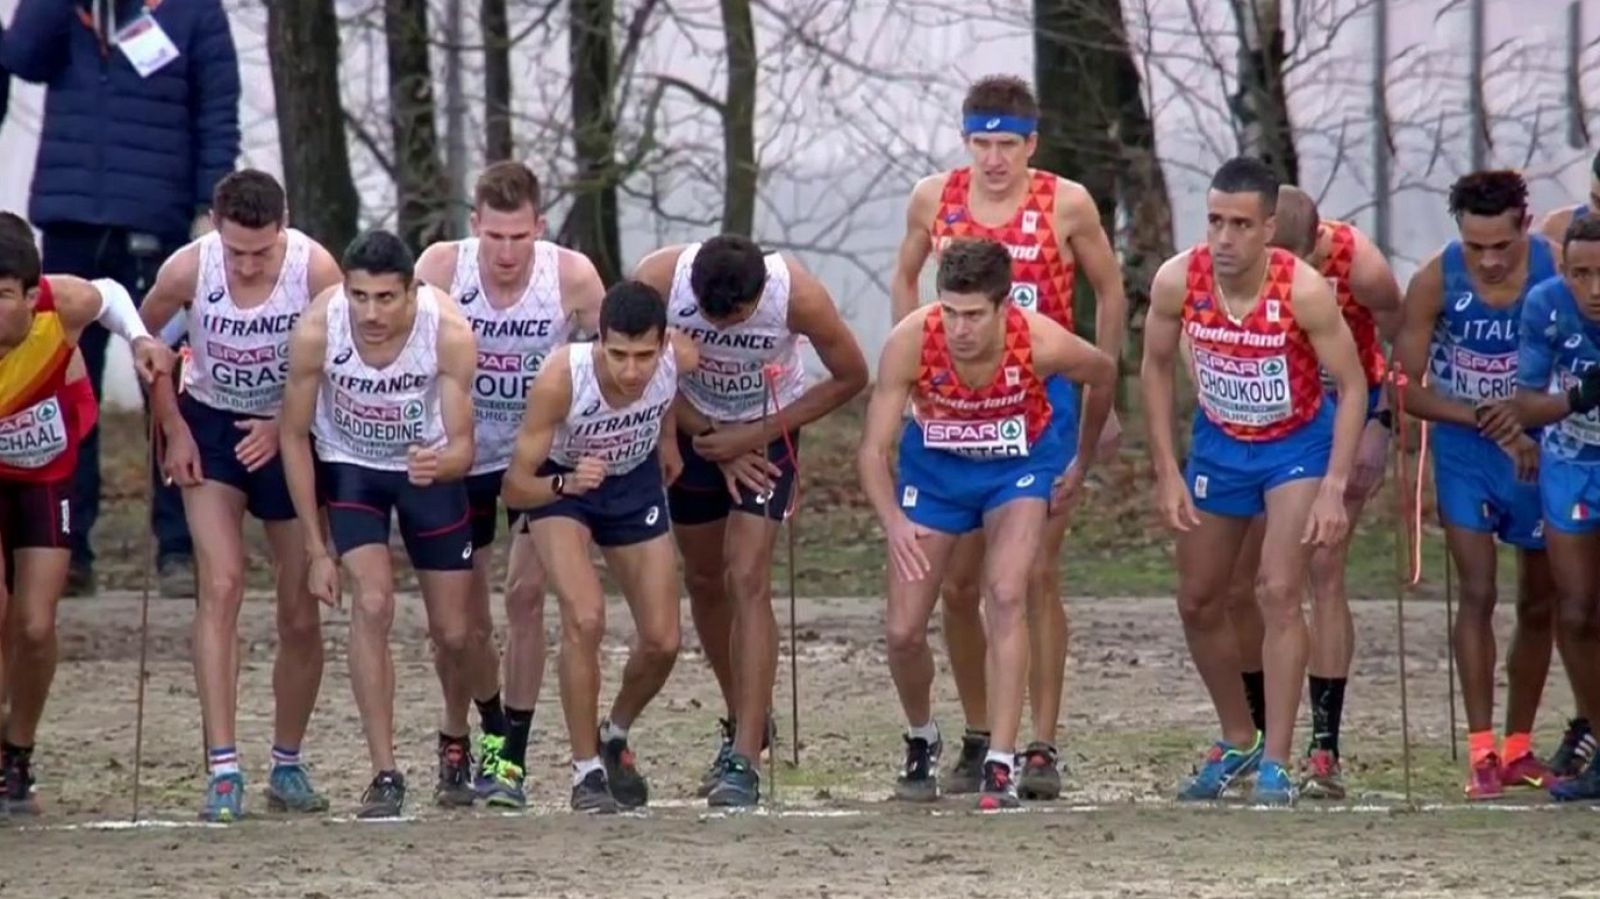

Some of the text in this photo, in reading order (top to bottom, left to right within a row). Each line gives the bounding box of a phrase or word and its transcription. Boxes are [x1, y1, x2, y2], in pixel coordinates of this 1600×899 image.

[691, 328, 777, 350] FRANCE
[1197, 350, 1258, 374] SPAR
[347, 373, 428, 394] FRANCE
[1199, 369, 1286, 403] CHOUKOUD
[334, 406, 423, 441] SADDEDINE
[928, 423, 997, 440] SPAR
